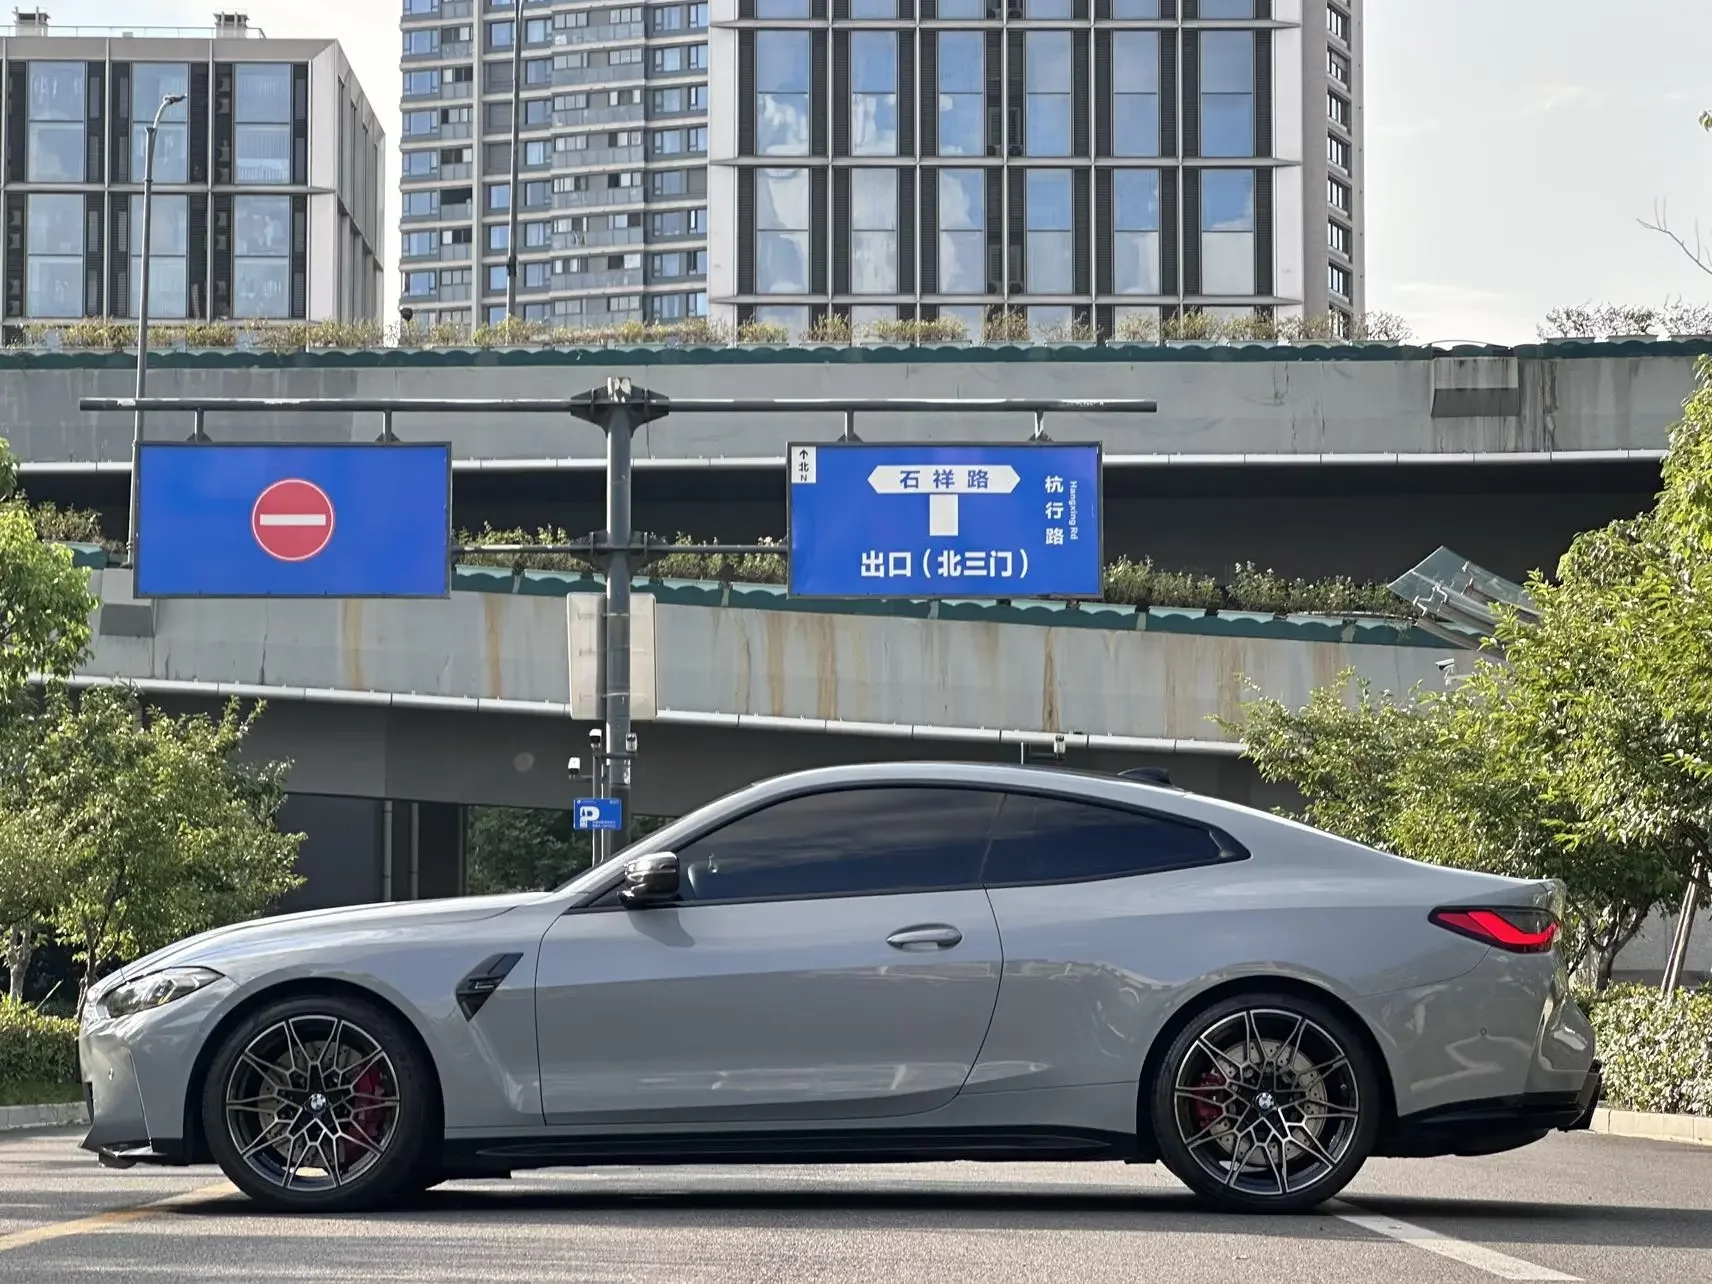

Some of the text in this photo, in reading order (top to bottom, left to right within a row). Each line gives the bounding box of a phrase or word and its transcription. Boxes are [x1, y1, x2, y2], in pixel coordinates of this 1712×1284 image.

[798, 461, 809, 473] 北
[800, 474, 808, 482] N
[899, 469, 989, 489] 石祥路
[1045, 475, 1064, 545] 杭行路
[1068, 480, 1079, 540] Hangxing Rd
[579, 806, 600, 828] P
